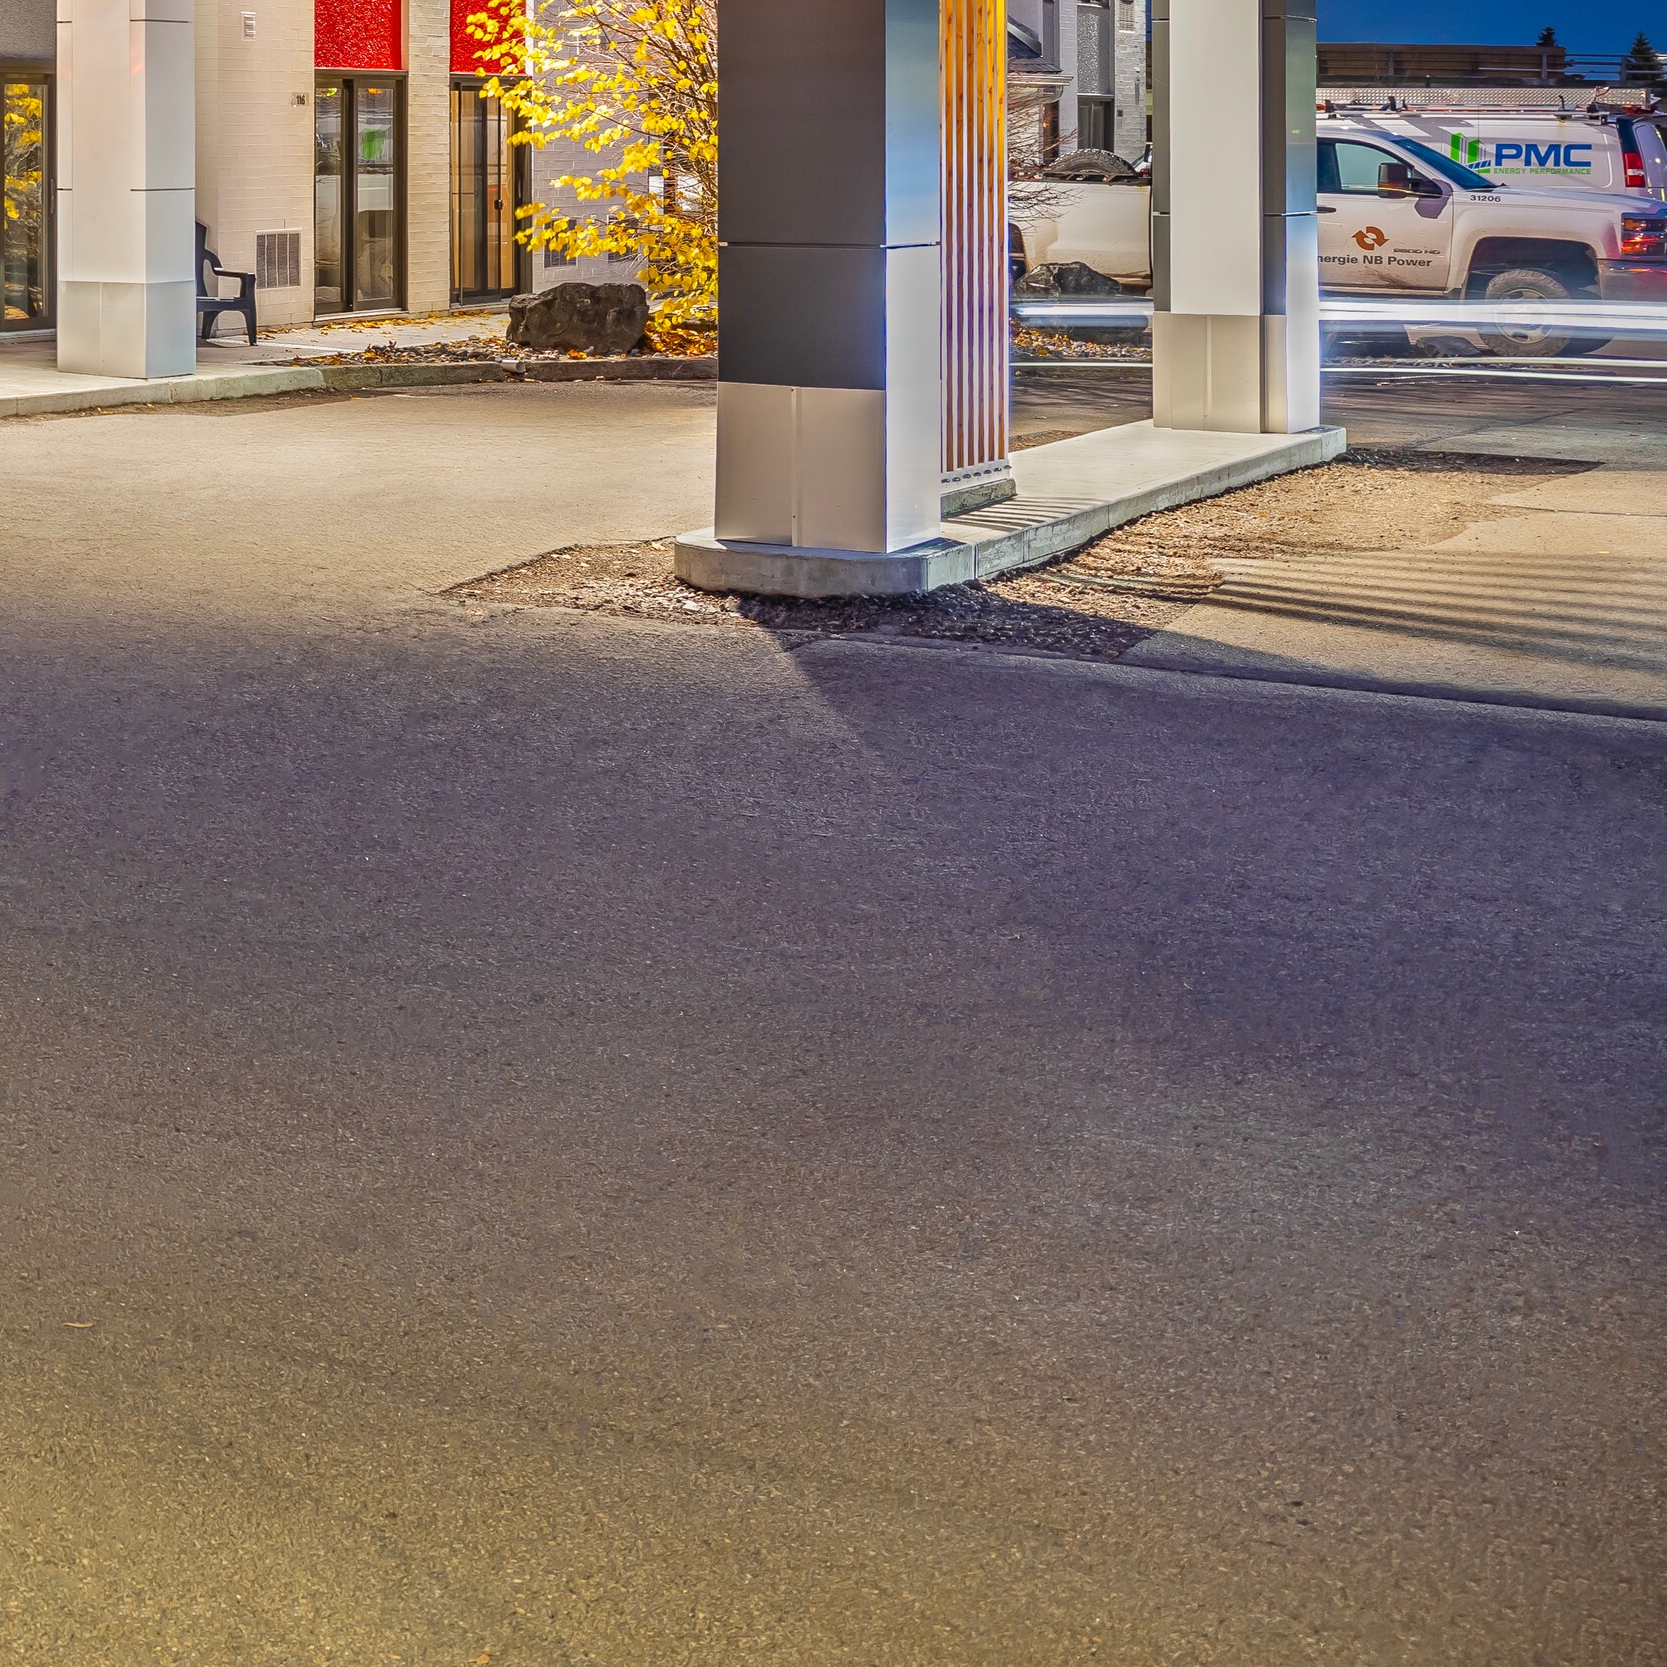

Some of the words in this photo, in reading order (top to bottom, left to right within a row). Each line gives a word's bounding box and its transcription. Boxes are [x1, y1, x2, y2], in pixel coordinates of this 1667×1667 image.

[1495, 143, 1592, 167] PMC
[1317, 254, 1358, 265] nergie
[1363, 255, 1383, 265] NB
[1387, 256, 1433, 267] Power
